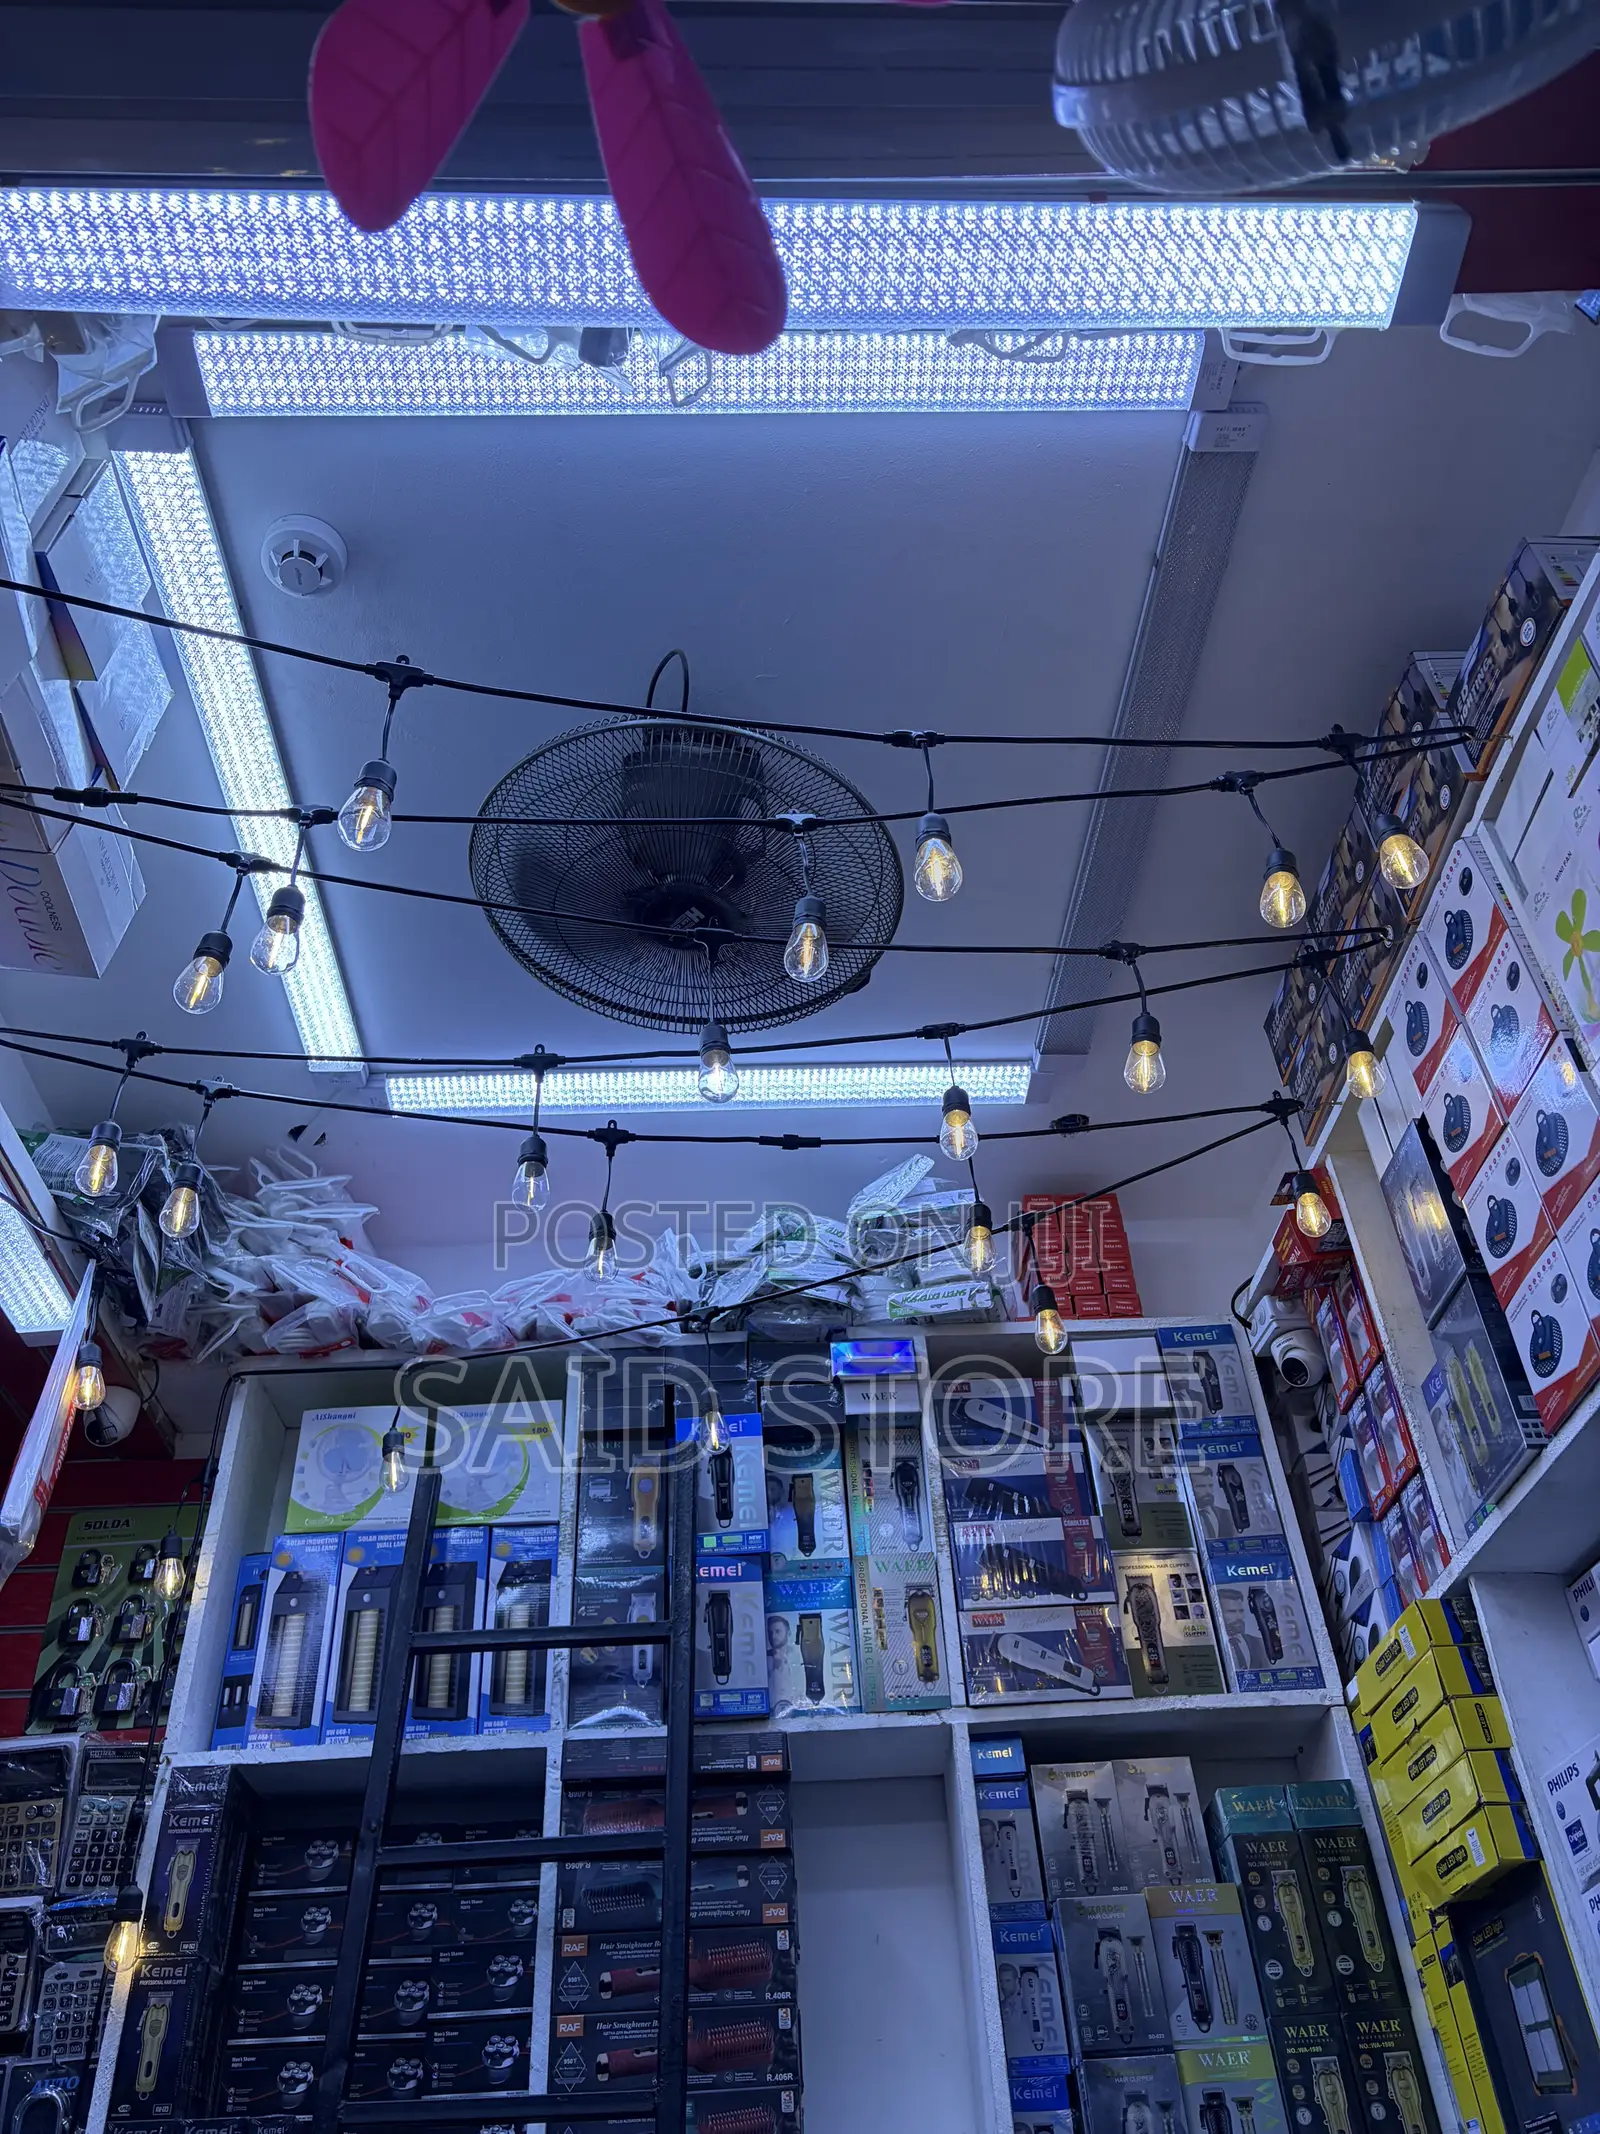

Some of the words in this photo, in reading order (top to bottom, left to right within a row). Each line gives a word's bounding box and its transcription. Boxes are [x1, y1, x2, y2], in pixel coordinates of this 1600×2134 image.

[1453, 684, 1469, 718] LED
[1555, 863, 1567, 883] MINI
[1564, 850, 1573, 868] FAN
[40, 890, 63, 932] COOLNESS
[1313, 902, 1325, 927] LED
[1339, 961, 1351, 988] LED
[1342, 949, 1365, 1000] LIGHTING
[943, 1289, 967, 1299] SAFETY
[1173, 1330, 1218, 1343] Kemei
[861, 1392, 898, 1401] WAER
[531, 1426, 549, 1435] 180
[1197, 1441, 1243, 1454] Kemei
[736, 1446, 758, 1528] Kemei
[820, 1470, 844, 1554] WAER
[83, 1518, 131, 1530] SOLDA
[393, 1540, 407, 1548] LAM
[875, 1559, 934, 1573] WAER
[1226, 1563, 1274, 1577] Kemei
[778, 1582, 833, 1595] WAER
[858, 1561, 870, 1625] PROFESSIONAL
[1573, 1575, 1596, 1603] PHILI
[1076, 1609, 1103, 1617] CORDLESS
[973, 1616, 1004, 1626] WAER
[863, 1627, 874, 1655] HAIR
[829, 1610, 856, 1704] WAER
[250, 1742, 268, 1750] 18W
[329, 1737, 348, 1745] 18W
[977, 1747, 1013, 1759] Kemei
[763, 1758, 782, 1767] RAF
[1547, 1762, 1580, 1796] PHILIPS
[178, 1781, 219, 1793] Kemei
[979, 1787, 1020, 1800] Kemei
[1232, 1799, 1277, 1813] WAER
[1301, 1795, 1345, 1808] WAER
[168, 1814, 215, 1828] Kemei
[698, 1835, 734, 1844] Straightener
[763, 1833, 784, 1842] RAF
[1568, 1827, 1584, 1843] Original
[1246, 1841, 1288, 1854] WAER
[1314, 1836, 1357, 1849] WAER
[1168, 1888, 1220, 1903] WAER
[698, 1910, 735, 1919] Straightener
[735, 1909, 751, 1917] Hair
[765, 1908, 786, 1917] RAF
[1101, 1912, 1126, 1920] CLIPPER
[999, 1930, 1042, 1943] Kemei
[564, 1943, 585, 1952] RAF
[615, 1941, 653, 1951] Straightener
[140, 1964, 189, 1978] Kemei
[765, 1991, 792, 2000] R.406R
[559, 2023, 581, 2032] RAF
[597, 2022, 611, 2031] Hair
[612, 2020, 651, 2030] Straightener
[1284, 2024, 1330, 2038] WAER
[1356, 2019, 1401, 2034] WAER
[1199, 2051, 1252, 2068] WAER
[766, 2073, 793, 2082] R.406R
[31, 2076, 80, 2093] AUTO
[1013, 2086, 1058, 2100] Kemei
